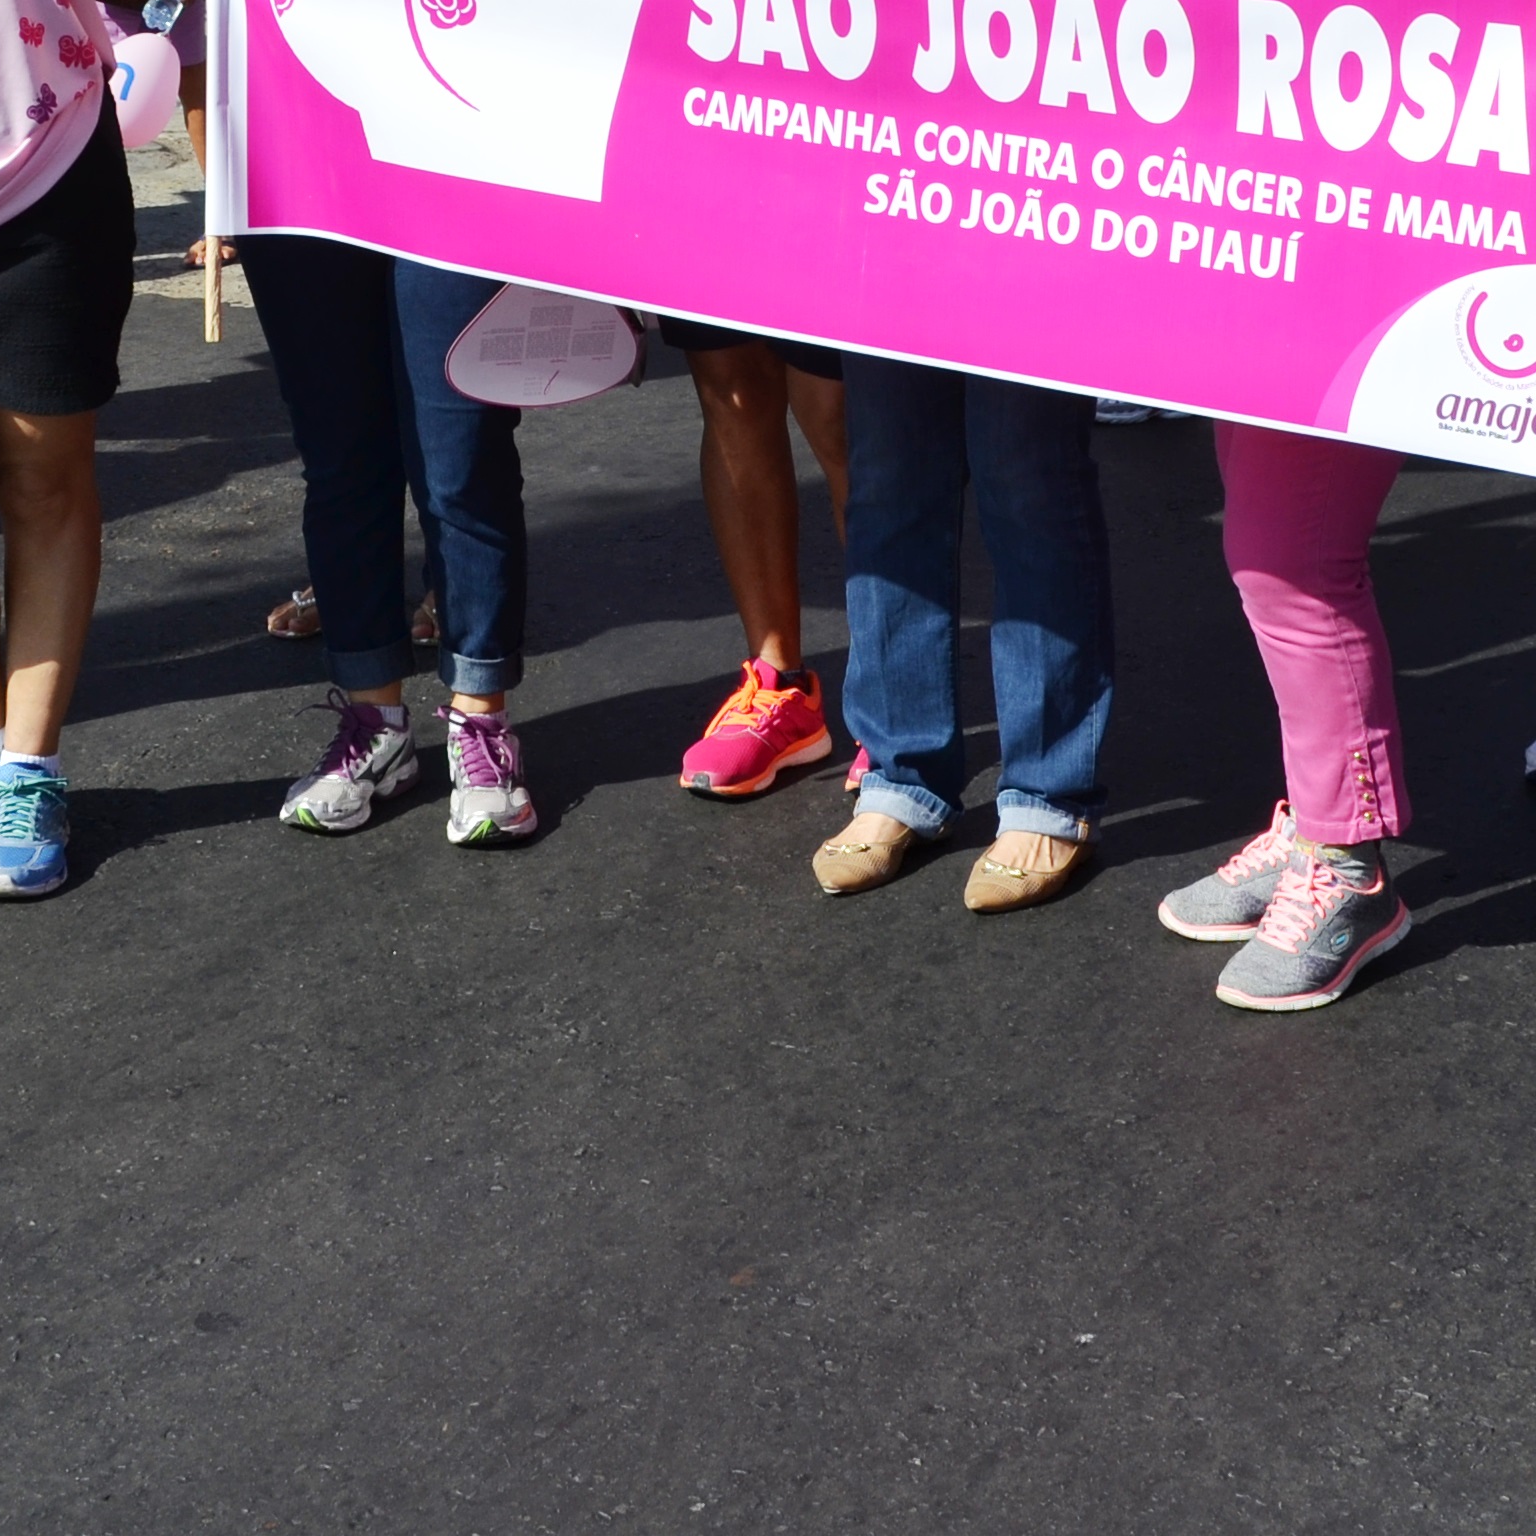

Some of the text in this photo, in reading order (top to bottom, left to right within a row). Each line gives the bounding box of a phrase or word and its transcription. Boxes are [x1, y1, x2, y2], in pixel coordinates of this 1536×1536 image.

[683, 87, 1527, 255] CAMPANHA CONTRA O CÂNCER DE MAMA
[863, 168, 1304, 283] SÃO JOÃO DO PIAUÍ
